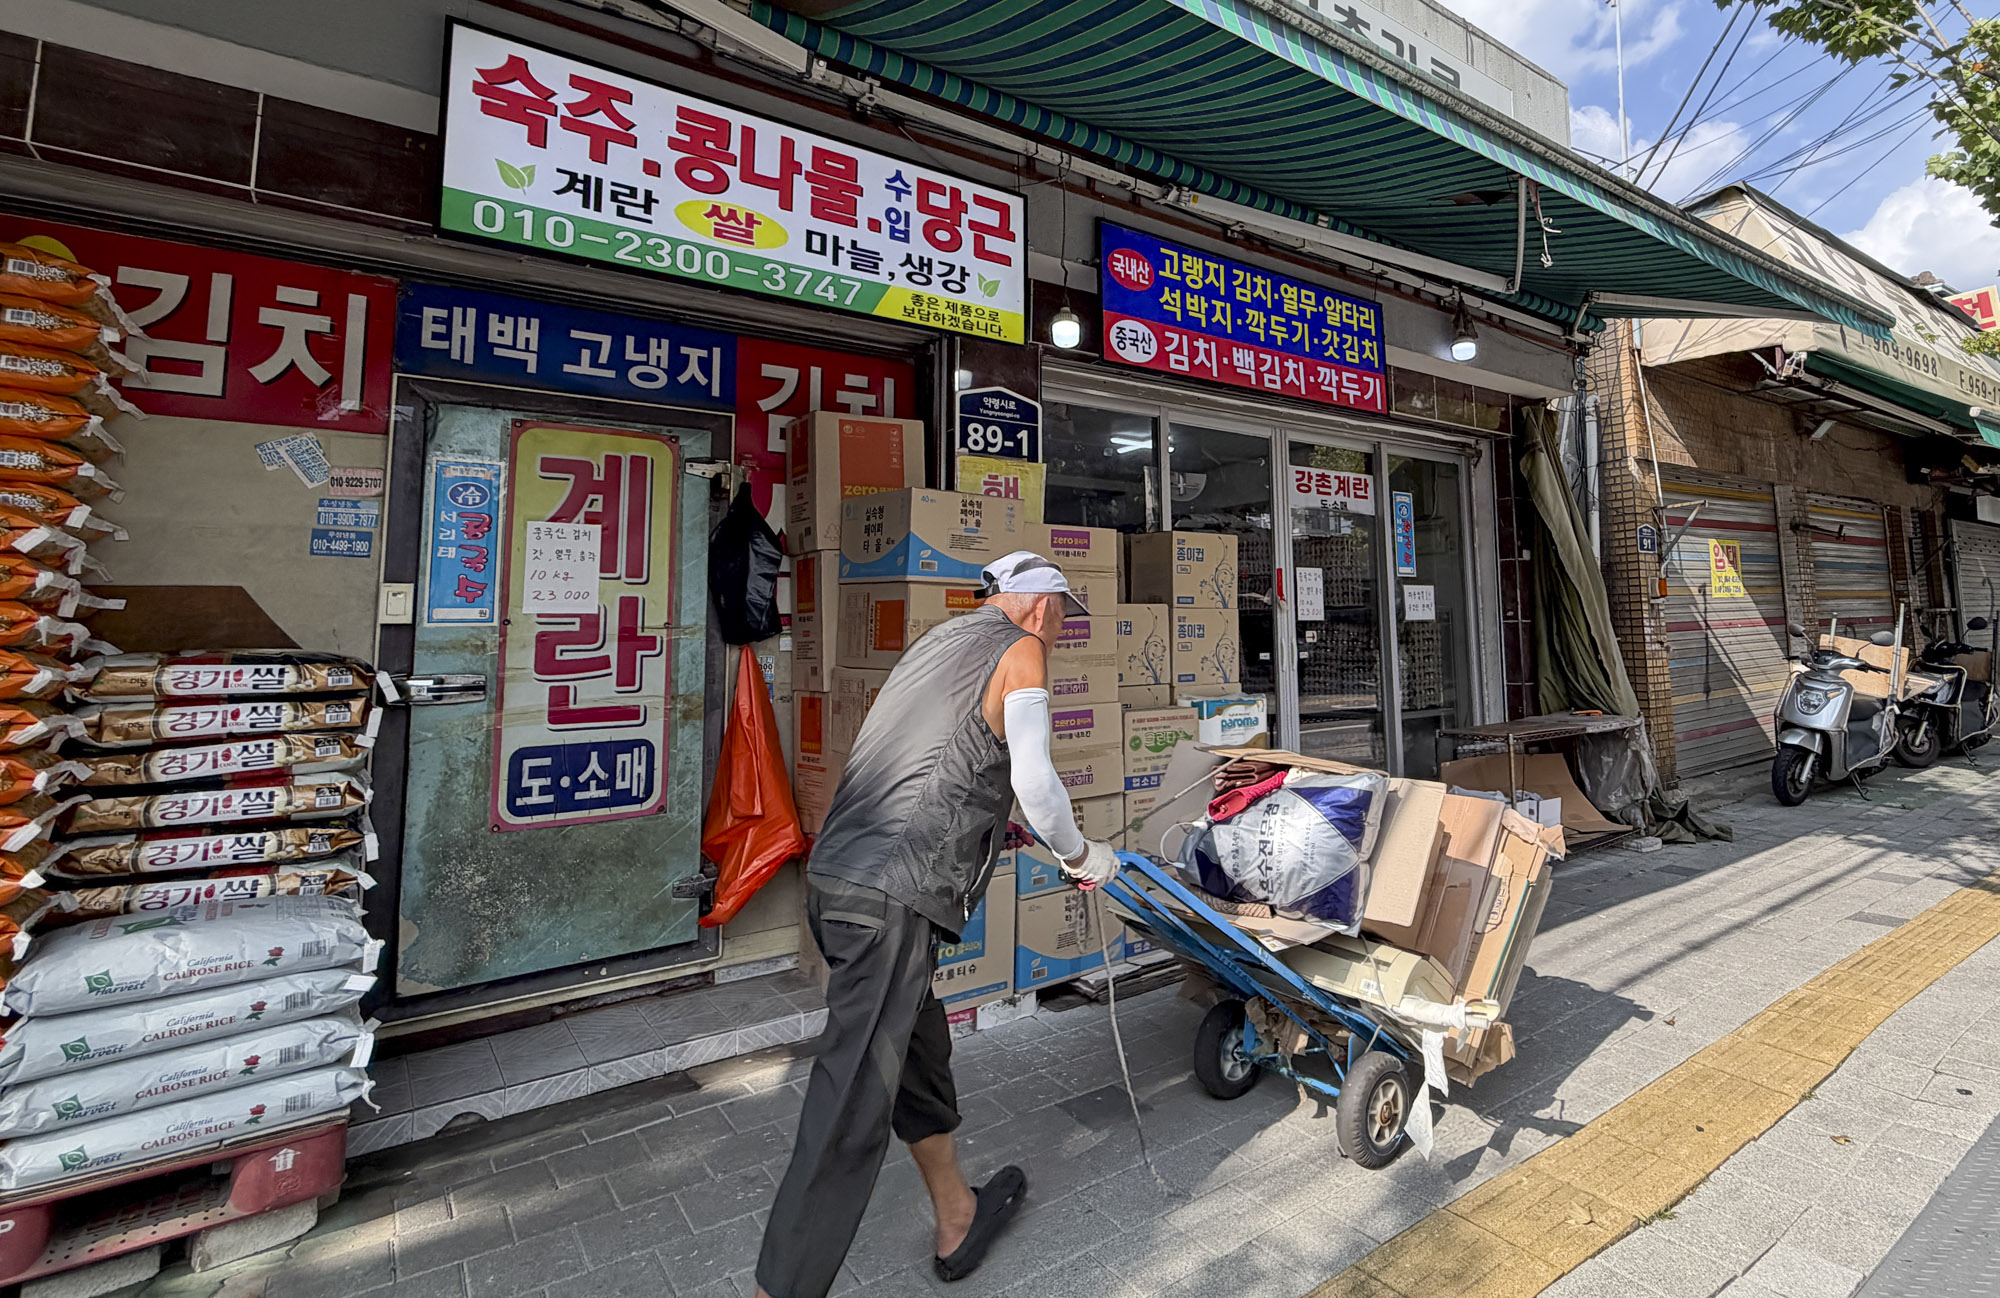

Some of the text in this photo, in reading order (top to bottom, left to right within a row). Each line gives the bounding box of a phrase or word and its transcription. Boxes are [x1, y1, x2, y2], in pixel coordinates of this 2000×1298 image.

[554, 168, 660, 225] 계란
[702, 201, 763, 247] 쌀
[915, 177, 1017, 267] 당근
[472, 198, 863, 306] 010-2300-3747
[1111, 258, 1151, 286] 국내산
[1158, 248, 1226, 295] 고랭지
[901, 305, 1008, 339] 보답하겠습니다.
[944, 300, 1001, 323] 제품으로
[115, 265, 368, 412] 김치
[1114, 328, 1153, 357] 중국산
[420, 306, 722, 397] 태백 고냉지
[983, 396, 1017, 411] 약령시로
[966, 422, 1029, 457] 89-1
[330, 476, 382, 489] 010-9229-5707
[844, 484, 878, 496] zero
[1295, 469, 1370, 501] 강촌계란
[455, 486, 483, 506] 冷
[437, 510, 457, 560] 서리태
[533, 527, 591, 541] 중국산 김치
[1053, 535, 1074, 545] zero
[1643, 538, 1651, 549] 91
[1177, 547, 1204, 562] 종이컵
[530, 569, 574, 581] 10 kg
[534, 453, 663, 731] 계란
[1178, 624, 1205, 638] 종이컵
[171, 667, 290, 690] 경기 쌀
[169, 704, 287, 732] 경기 쌀
[1221, 716, 1259, 732] paroma
[159, 742, 279, 775] 경기 쌀
[515, 745, 647, 807] 도·소매
[159, 790, 280, 820] 경기 쌀
[148, 835, 270, 866] 경기 쌀
[163, 959, 255, 982] CALROSE RICE
[187, 953, 234, 967] California
[94, 981, 147, 997] Harvest
[142, 1016, 237, 1043] CALROSE RICE
[166, 1011, 215, 1028] California
[73, 1044, 125, 1062] Harvest
[135, 1070, 231, 1100] CALROSE RICE
[159, 1066, 208, 1083] California
[65, 1101, 117, 1120] Harvest
[141, 1120, 236, 1151] CALROSE RICE
[166, 1116, 214, 1134] California
[70, 1152, 122, 1172] Harvest
